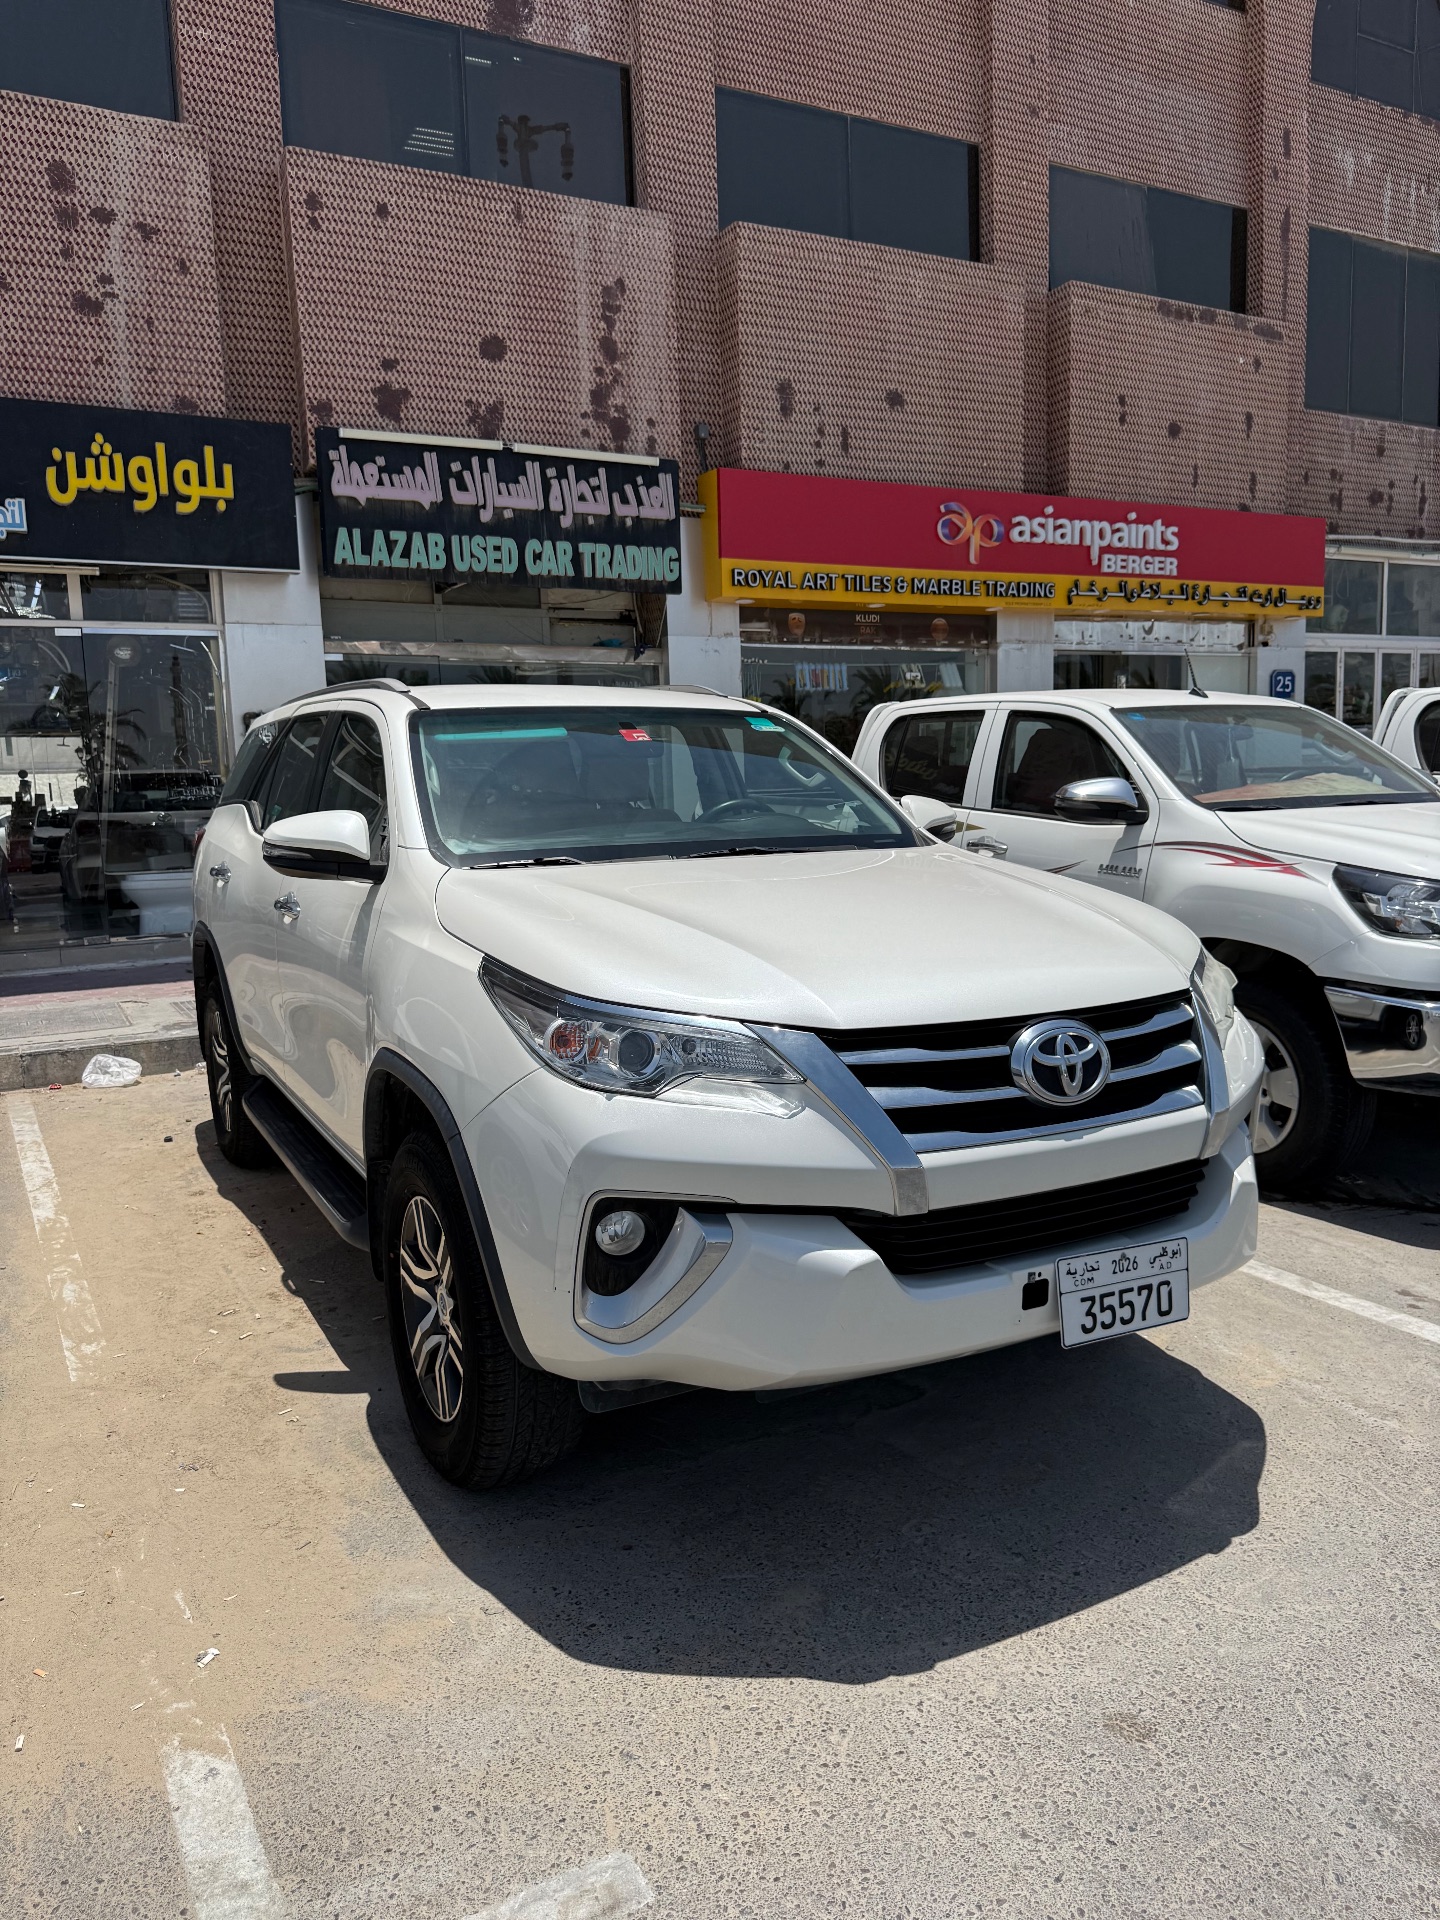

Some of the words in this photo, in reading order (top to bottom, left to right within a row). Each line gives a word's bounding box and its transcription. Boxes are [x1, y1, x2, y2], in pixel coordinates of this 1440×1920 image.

[328, 445, 443, 511] المستعملة
[449, 456, 544, 522] السيارات
[546, 464, 610, 528] لتجارة
[1009, 505, 1179, 565] asianpaints
[333, 527, 446, 570] ALAZAB
[451, 534, 518, 574] USED
[524, 538, 575, 577] CAR
[578, 542, 680, 582] TRADING
[1101, 554, 1178, 576] BERGER
[732, 568, 797, 589] ROYAL
[802, 572, 838, 591] ART
[843, 574, 892, 593] TILES
[895, 576, 908, 593] &
[912, 578, 982, 596] MARBLE
[986, 580, 1056, 598] TRADING
[1067, 579, 1137, 605] والرخام
[1137, 580, 1189, 605] البلاط
[1191, 584, 1248, 607] لتجارة
[855, 614, 880, 623] KLUDI
[1276, 676, 1292, 692] 25
[1066, 1260, 1100, 1279] تجارية
[1111, 1255, 1138, 1274] 2026
[1073, 1276, 1095, 1288] COM
[1080, 1280, 1173, 1334] 35570
